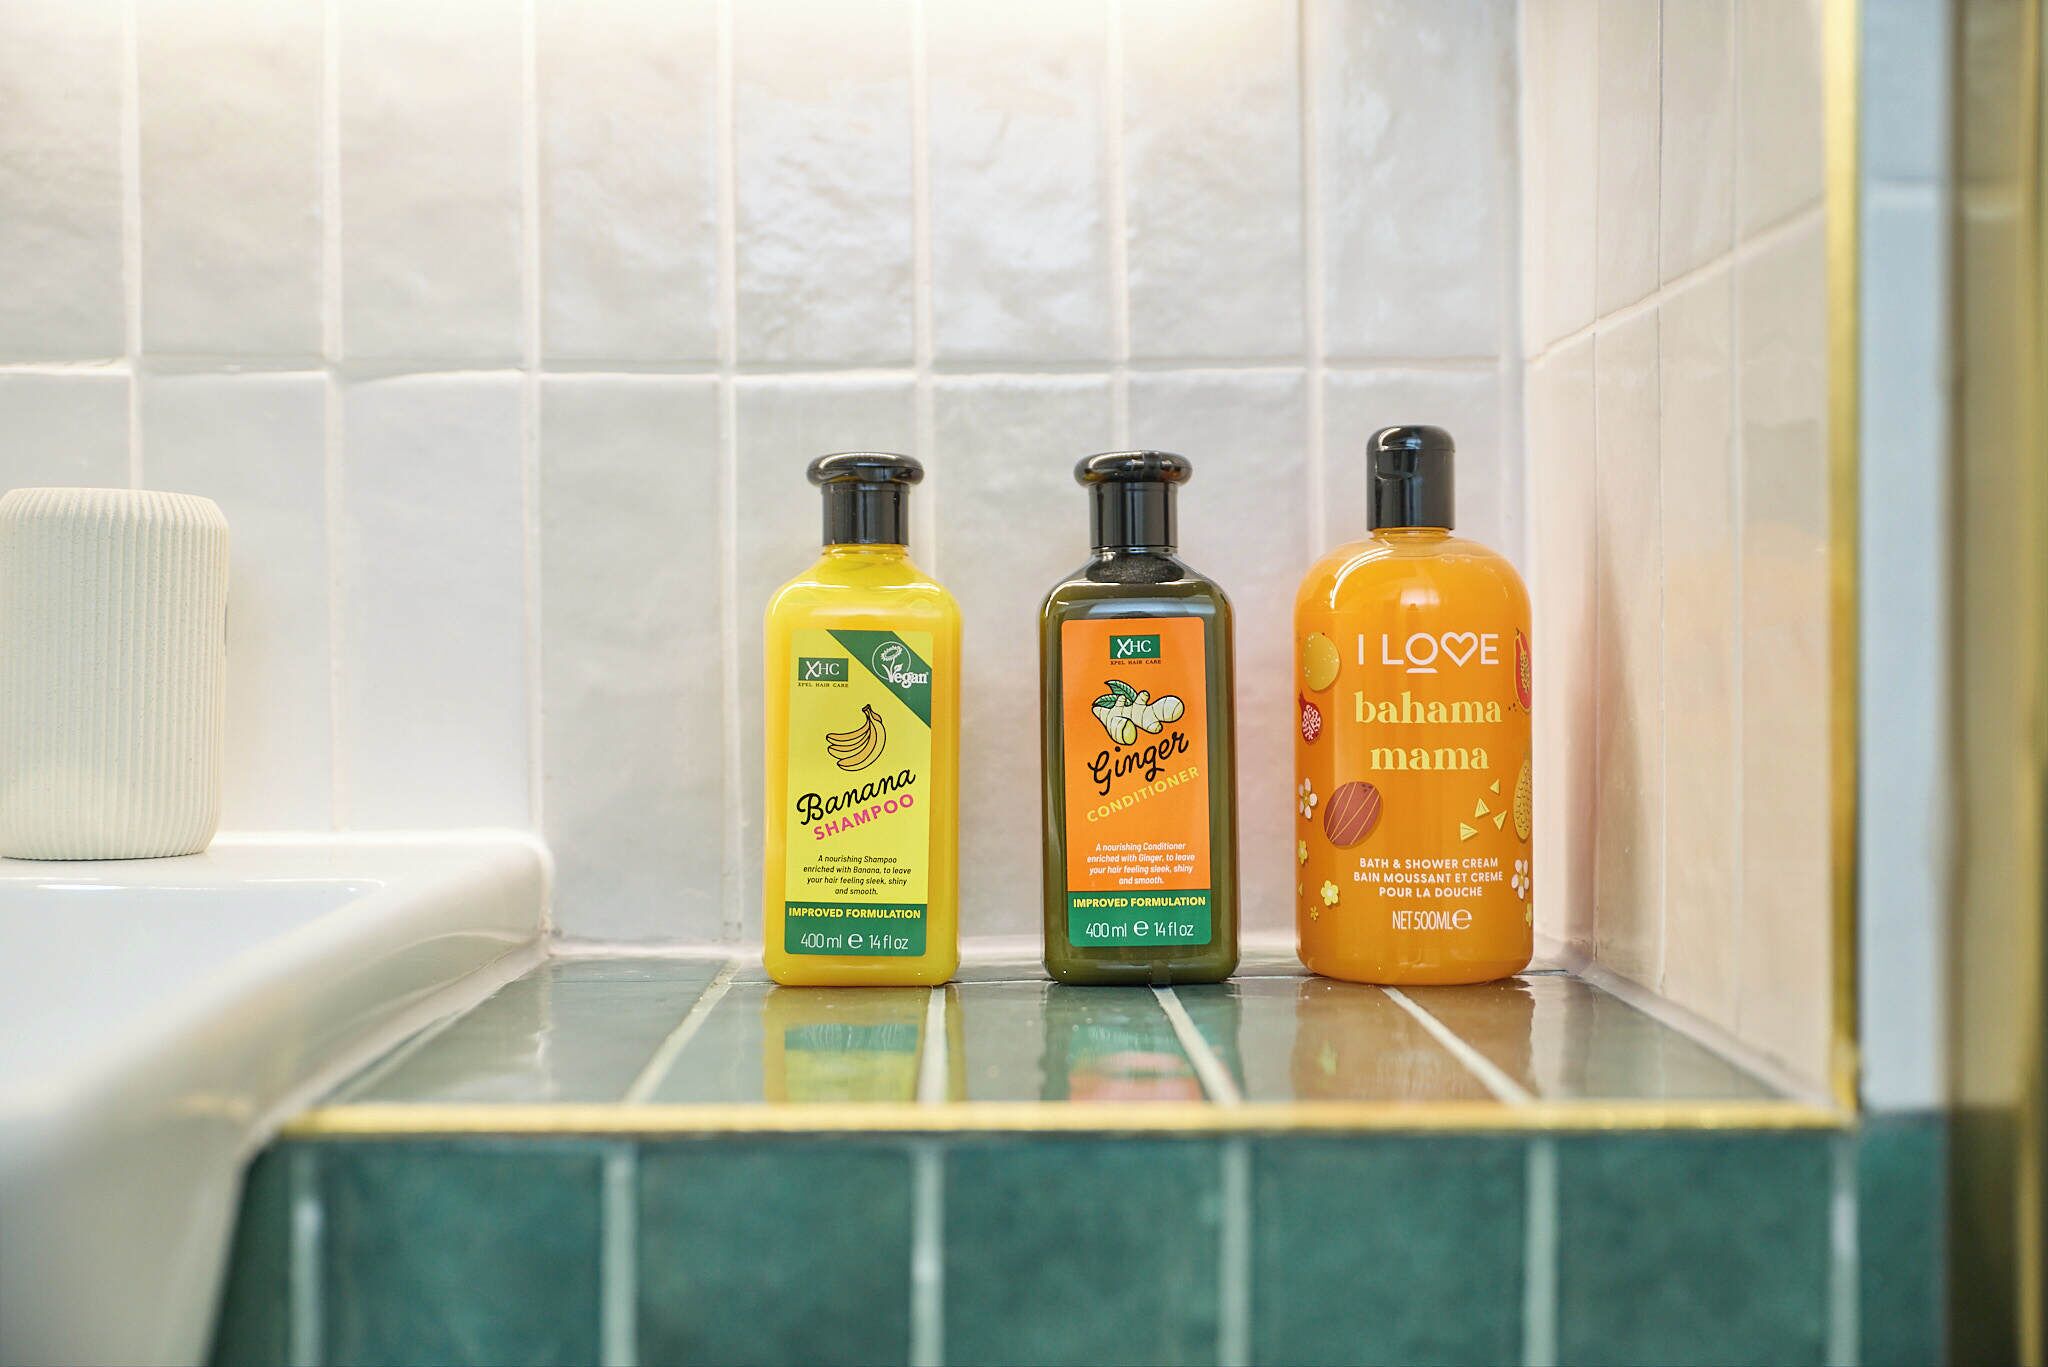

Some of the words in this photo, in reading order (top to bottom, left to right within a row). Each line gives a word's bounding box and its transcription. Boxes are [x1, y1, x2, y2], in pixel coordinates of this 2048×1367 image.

[1117, 639, 1151, 658] XHC
[1358, 634, 1365, 665] I
[805, 660, 840, 680] XHC
[882, 664, 928, 688] Vegan
[1353, 691, 1502, 724] bahama
[1088, 732, 1189, 796] Ginger
[1370, 748, 1489, 770] mama
[796, 769, 916, 826] Banana
[1087, 766, 1199, 822] CONDITIONER
[813, 793, 914, 840] SHAMPOO
[1096, 844, 1101, 852] A
[1103, 843, 1141, 853] nourishing
[1143, 842, 1186, 850] Conditioner
[825, 855, 862, 864] nourishing
[864, 856, 897, 865] Shampoo
[1087, 855, 1119, 863] enriched
[1121, 854, 1137, 862] with
[1139, 854, 1164, 863] Ginger,
[1176, 853, 1195, 861] leave
[1359, 858, 1389, 869] BATH
[1393, 859, 1400, 868] &
[1405, 859, 1458, 869] SHOWER
[1462, 858, 1498, 868] CREAM
[1089, 867, 1105, 875] your
[1107, 866, 1121, 874] hair
[1123, 865, 1149, 874] feeling
[1150, 865, 1172, 873] sleek,
[1174, 865, 1193, 873] shiny
[1354, 872, 1380, 882] BAIN
[1384, 873, 1451, 883] MOUSSANT
[1455, 873, 1466, 882] ET
[1471, 871, 1503, 882] CREME
[840, 877, 864, 885] feeling
[889, 878, 907, 886] shiny
[1119, 877, 1133, 885] and
[1134, 876, 1164, 884] smooth.
[1379, 887, 1412, 897] POUR
[1416, 887, 1430, 897] LA
[1435, 887, 1483, 897] DOUCHE
[1073, 898, 1128, 908] IMPROVED
[1131, 897, 1205, 907] FORMULATION
[789, 907, 843, 918] IMPROVED
[846, 909, 921, 919] FORMULATION
[1392, 910, 1413, 929] NET
[1086, 923, 1109, 938] 400
[1112, 923, 1127, 937] ml
[1154, 922, 1165, 936] 14
[1168, 922, 1177, 936] fl
[1179, 924, 1194, 936] oz
[801, 933, 824, 948] 400
[826, 934, 842, 948] ml
[869, 935, 881, 949] 14
[884, 935, 891, 949] fl
[894, 938, 909, 949] oz
